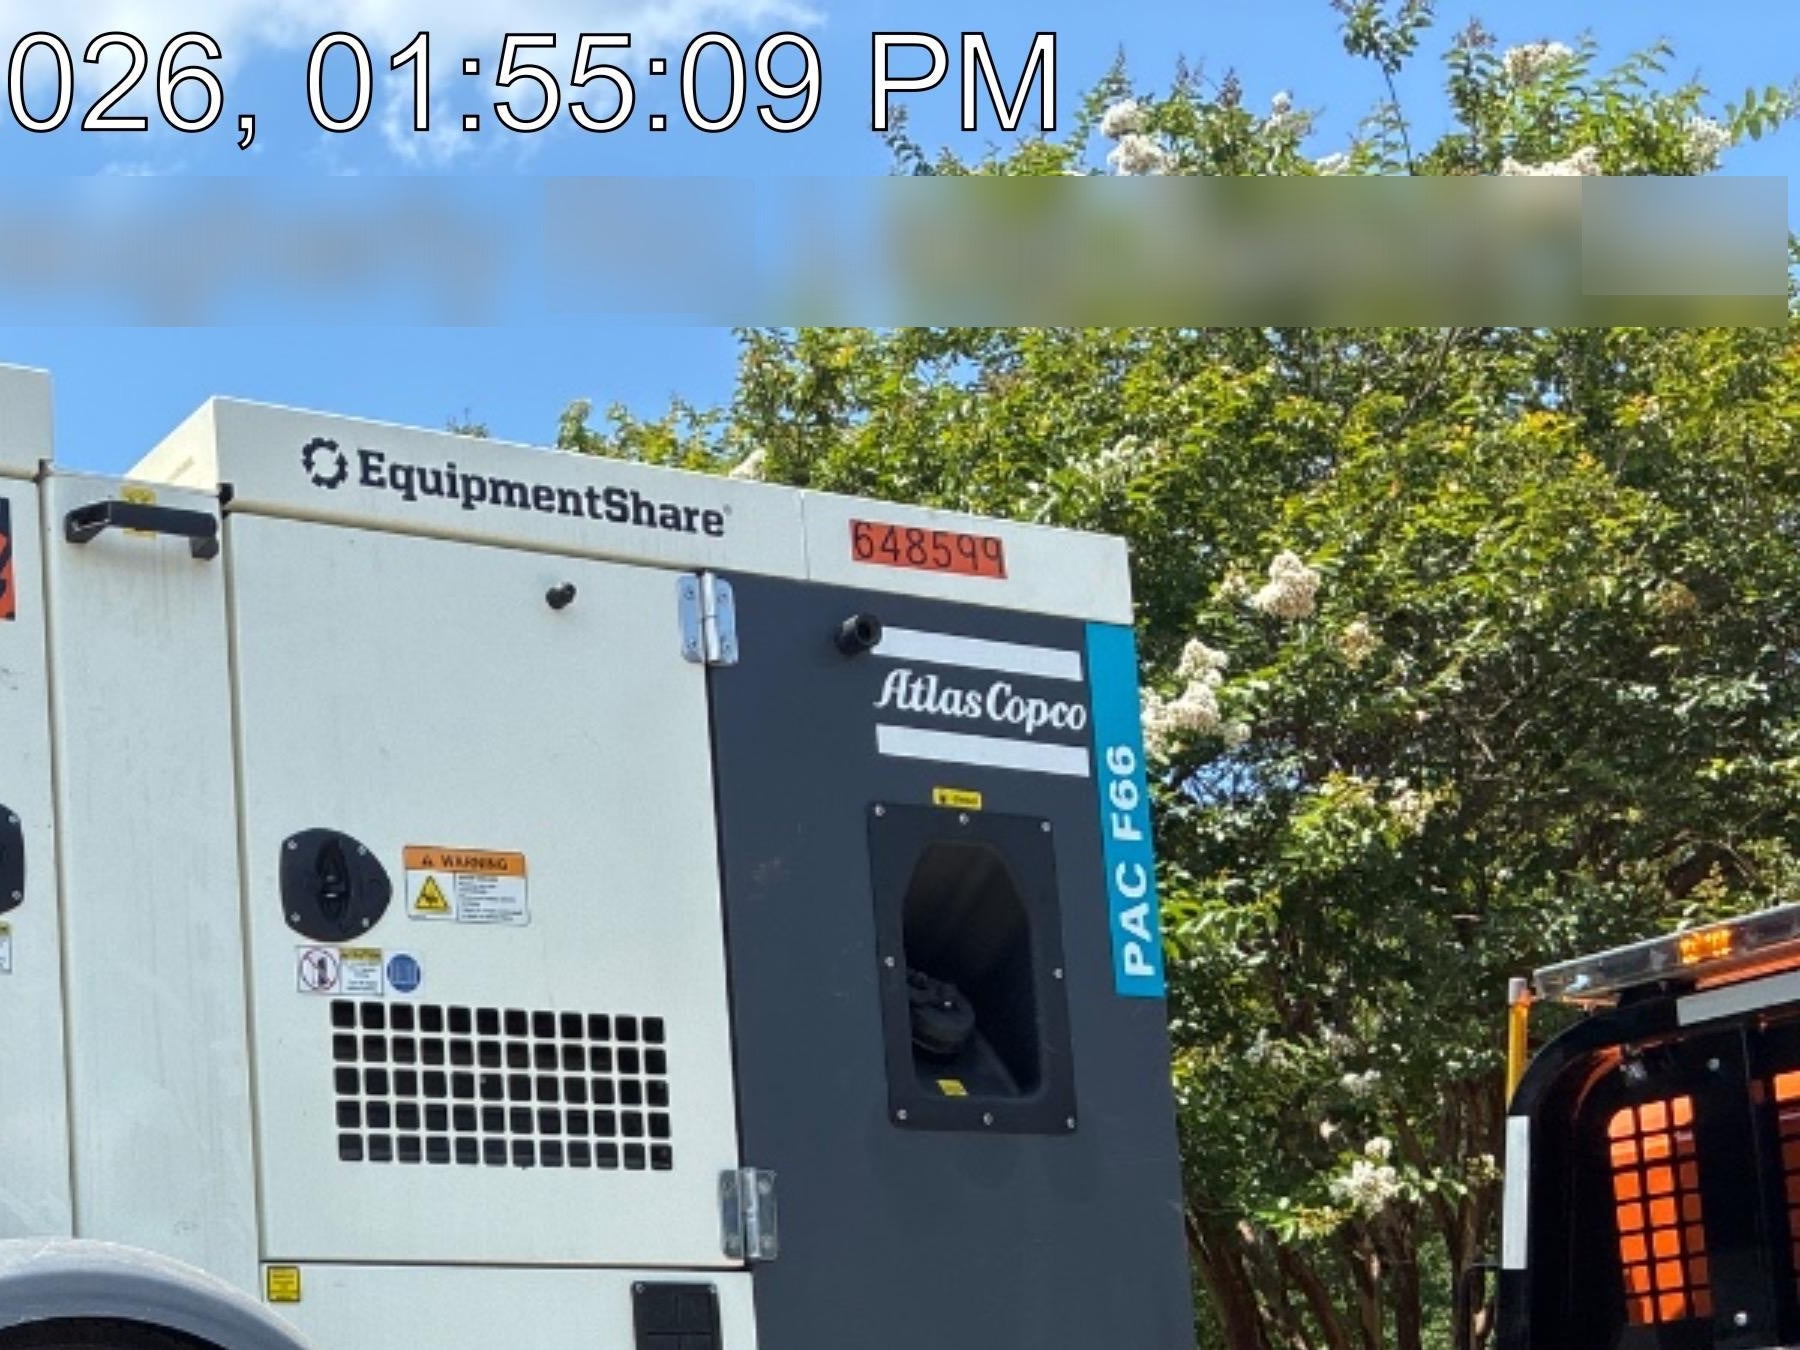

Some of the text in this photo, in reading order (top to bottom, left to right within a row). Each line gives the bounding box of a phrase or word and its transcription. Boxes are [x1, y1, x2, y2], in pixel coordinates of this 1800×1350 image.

[357, 448, 726, 538] EquipmentShare
[853, 519, 1004, 574] 648599
[872, 667, 1088, 736] Atlas Copco
[440, 854, 509, 872] WARNING
[1105, 745, 1156, 977] PAC F66
